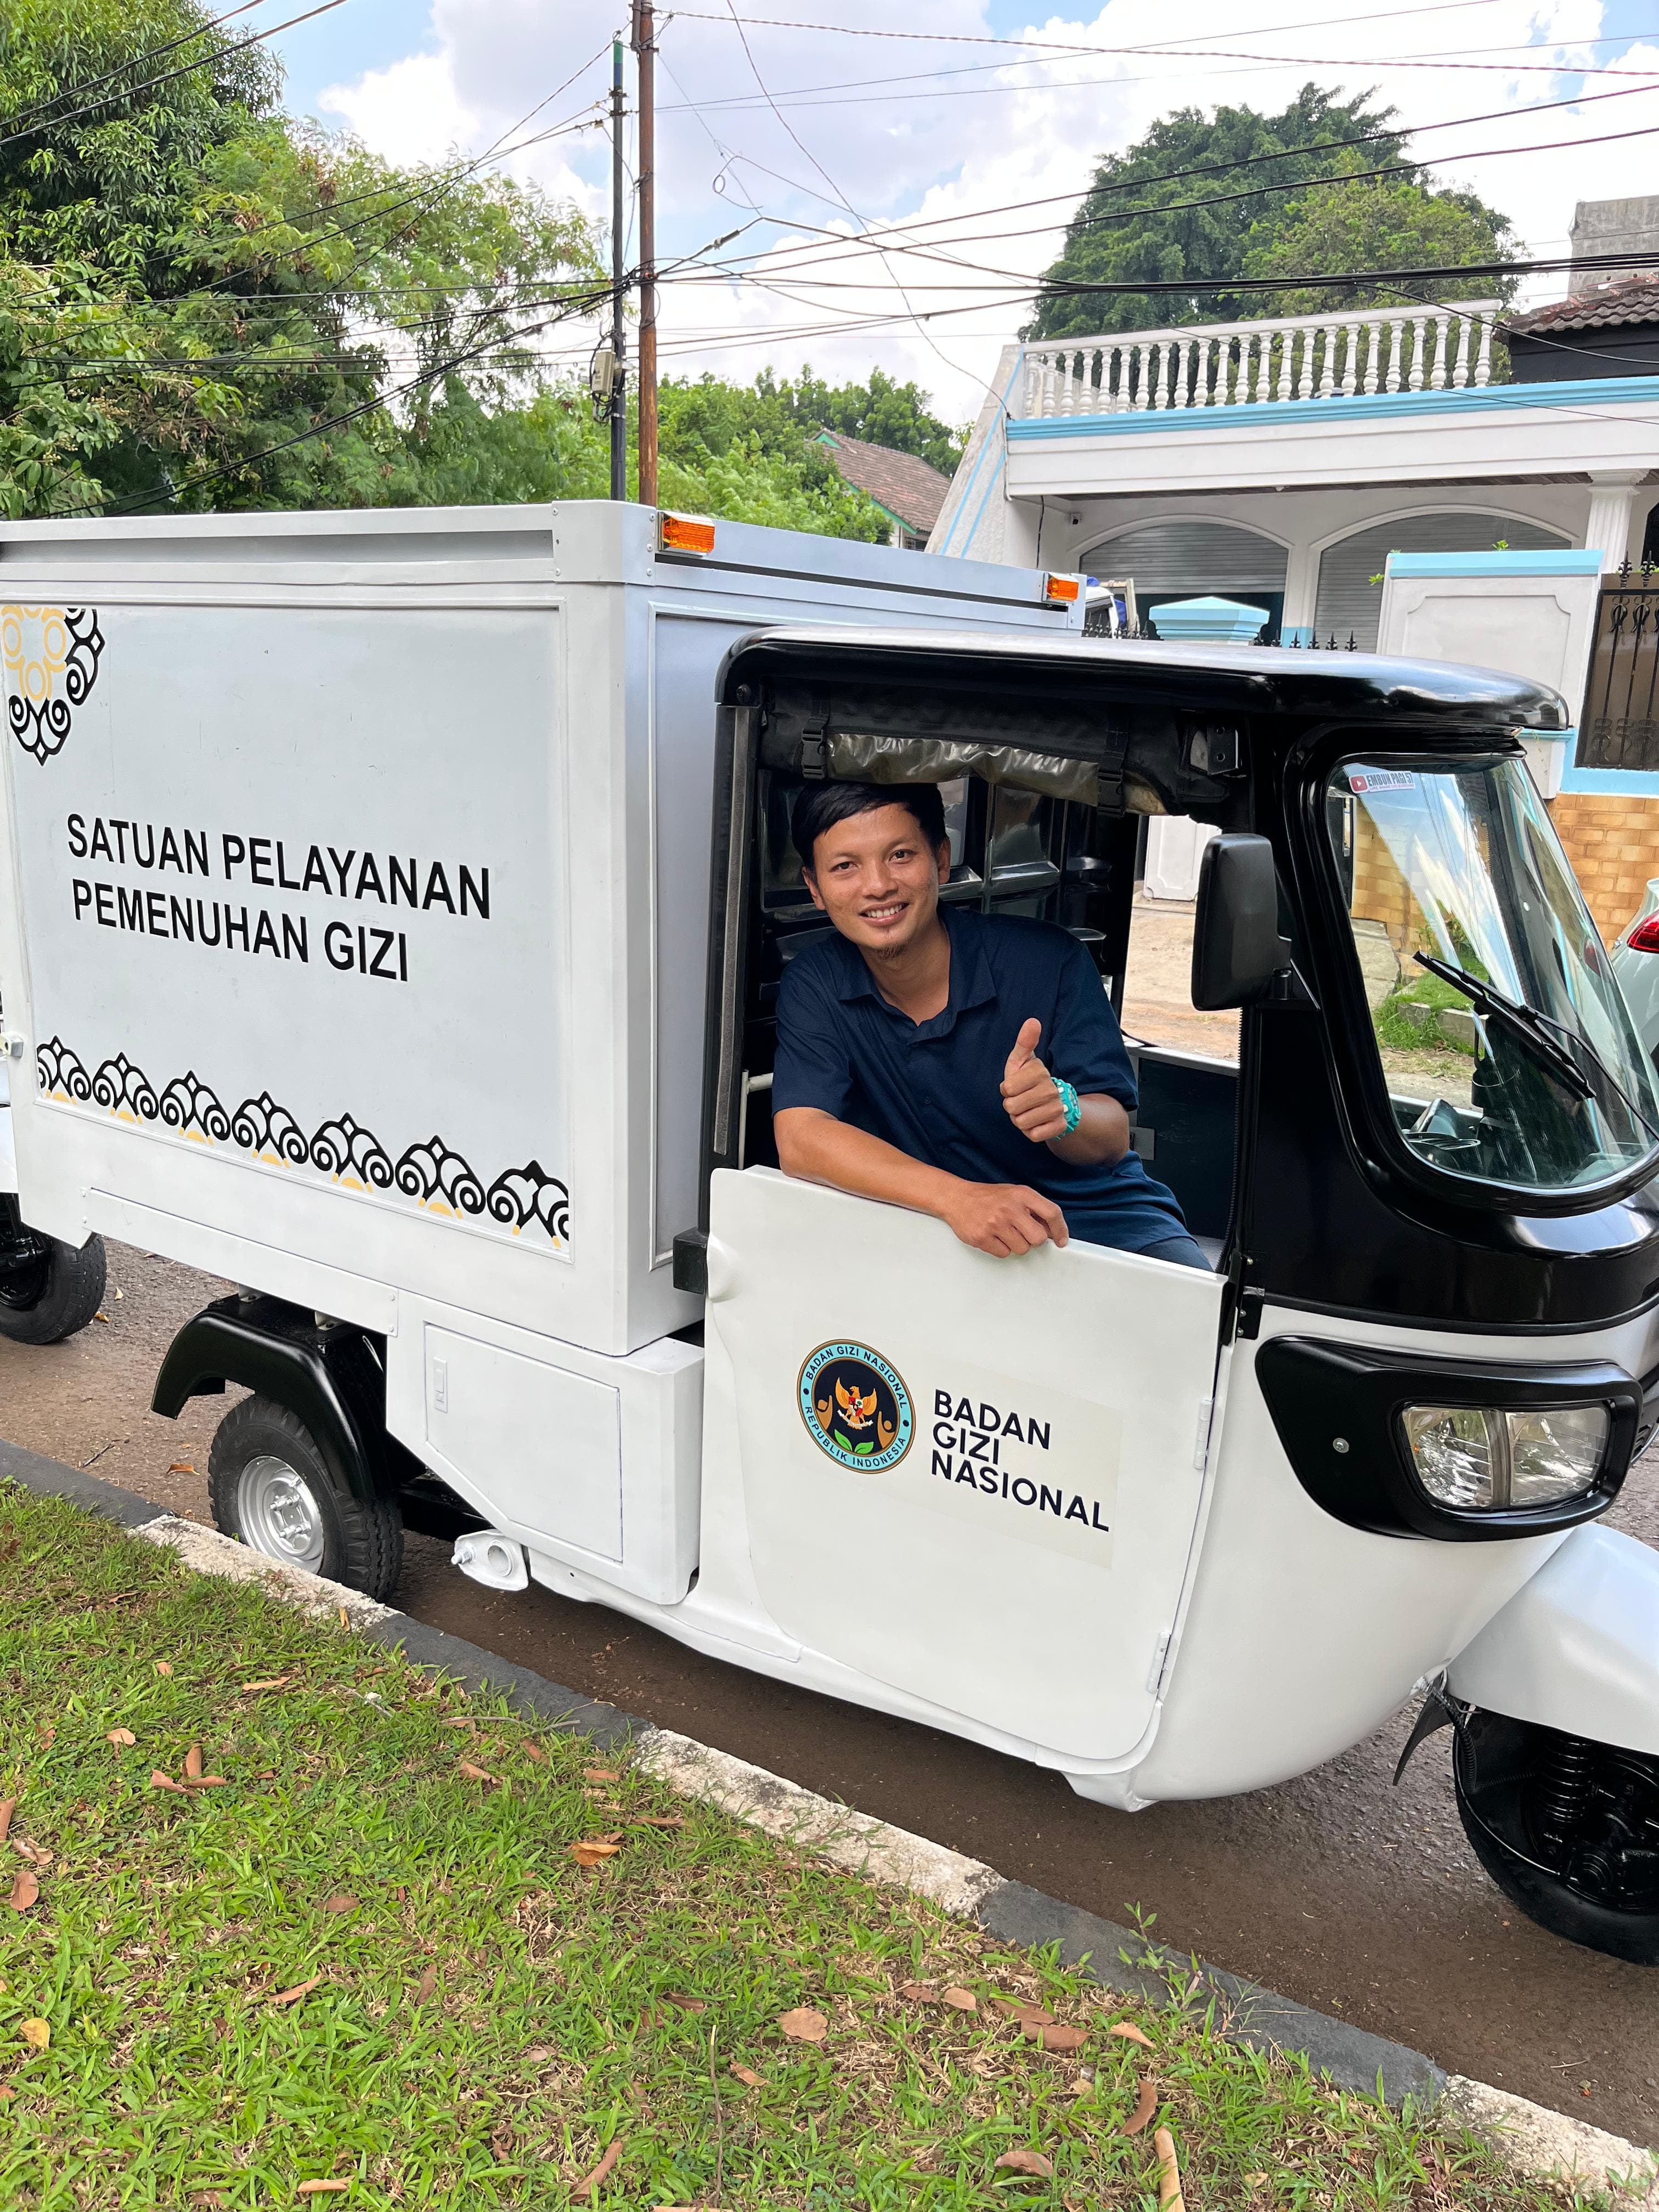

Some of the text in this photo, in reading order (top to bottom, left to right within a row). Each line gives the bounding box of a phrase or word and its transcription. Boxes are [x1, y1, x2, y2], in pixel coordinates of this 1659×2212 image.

[1366, 774, 1392, 786] EMBUN
[1391, 772, 1406, 785] PAGI
[1405, 772, 1414, 784] 57
[67, 813, 490, 920] SATUAN PELAYANAN
[72, 878, 408, 983] PEMENUHAN GIZI
[805, 1346, 907, 1409] BADAN GIZI NASIONAL
[805, 1406, 906, 1468] REPUBLIK INDONESIA
[932, 1421, 1000, 1466] GIZI
[934, 1389, 1051, 1451] BADAN
[931, 1449, 1109, 1533] NASIONAL
